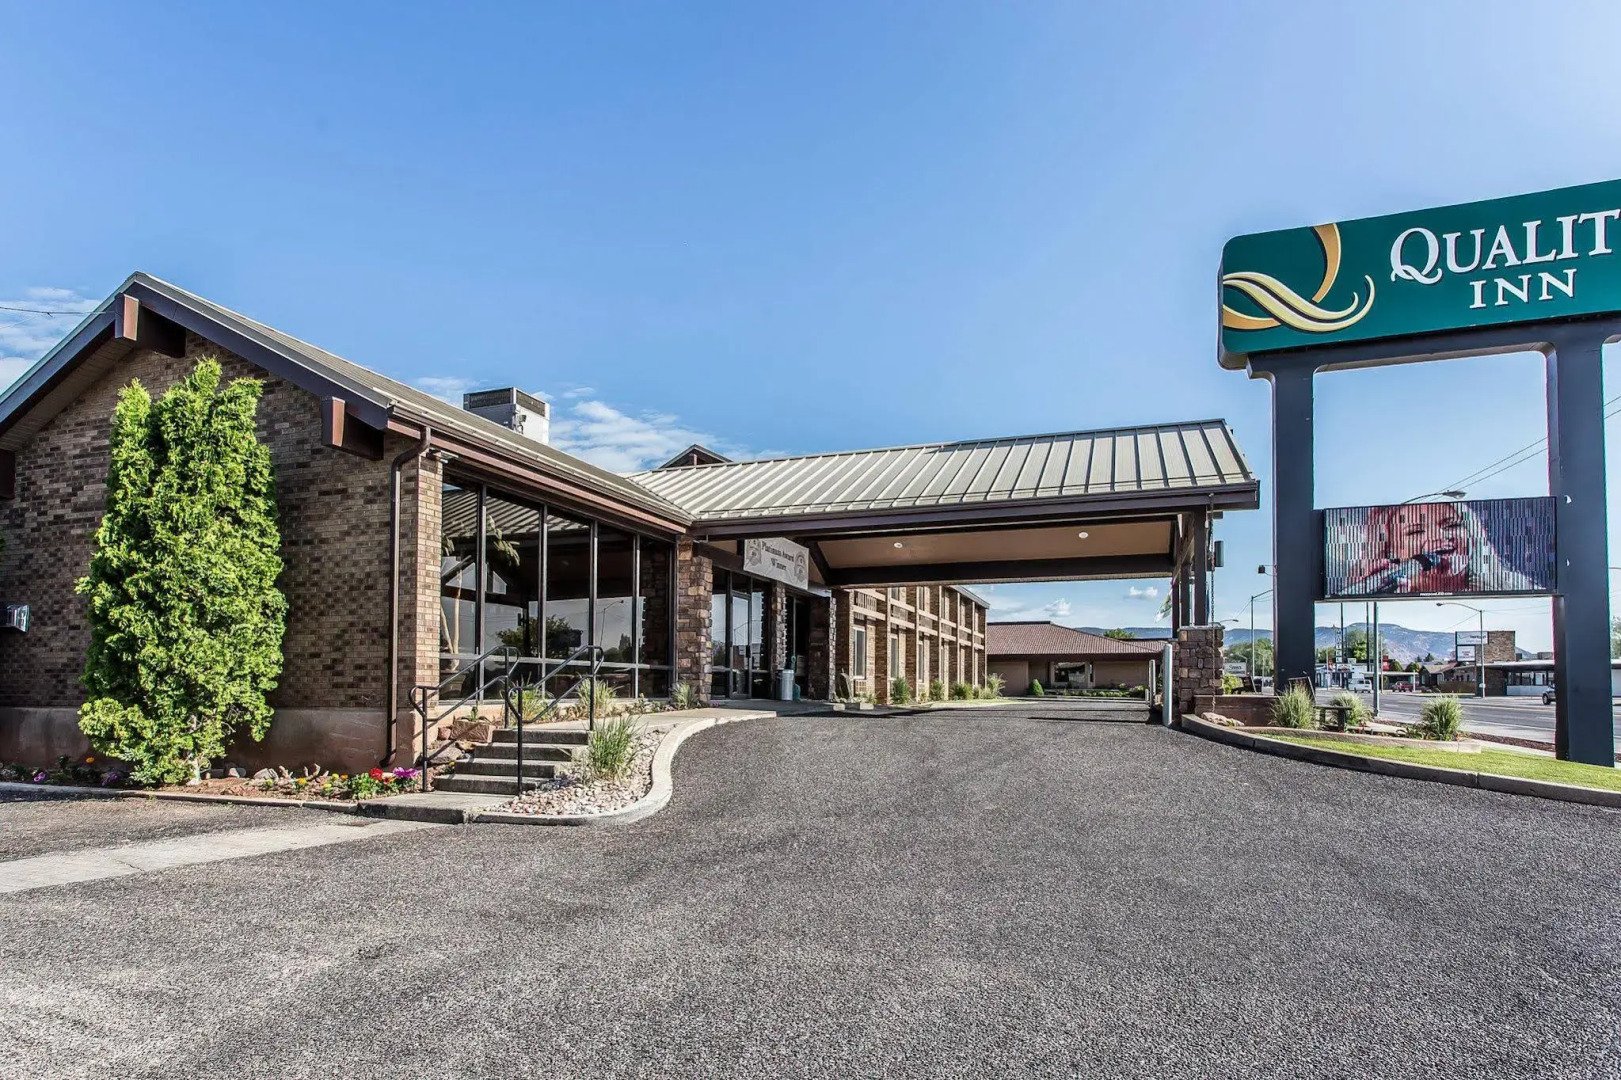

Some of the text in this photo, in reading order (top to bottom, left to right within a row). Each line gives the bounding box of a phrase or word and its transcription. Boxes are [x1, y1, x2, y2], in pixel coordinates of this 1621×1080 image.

[1390, 208, 1621, 285] QUALIT
[1469, 268, 1577, 309] INN
[782, 550, 795, 562] Award
